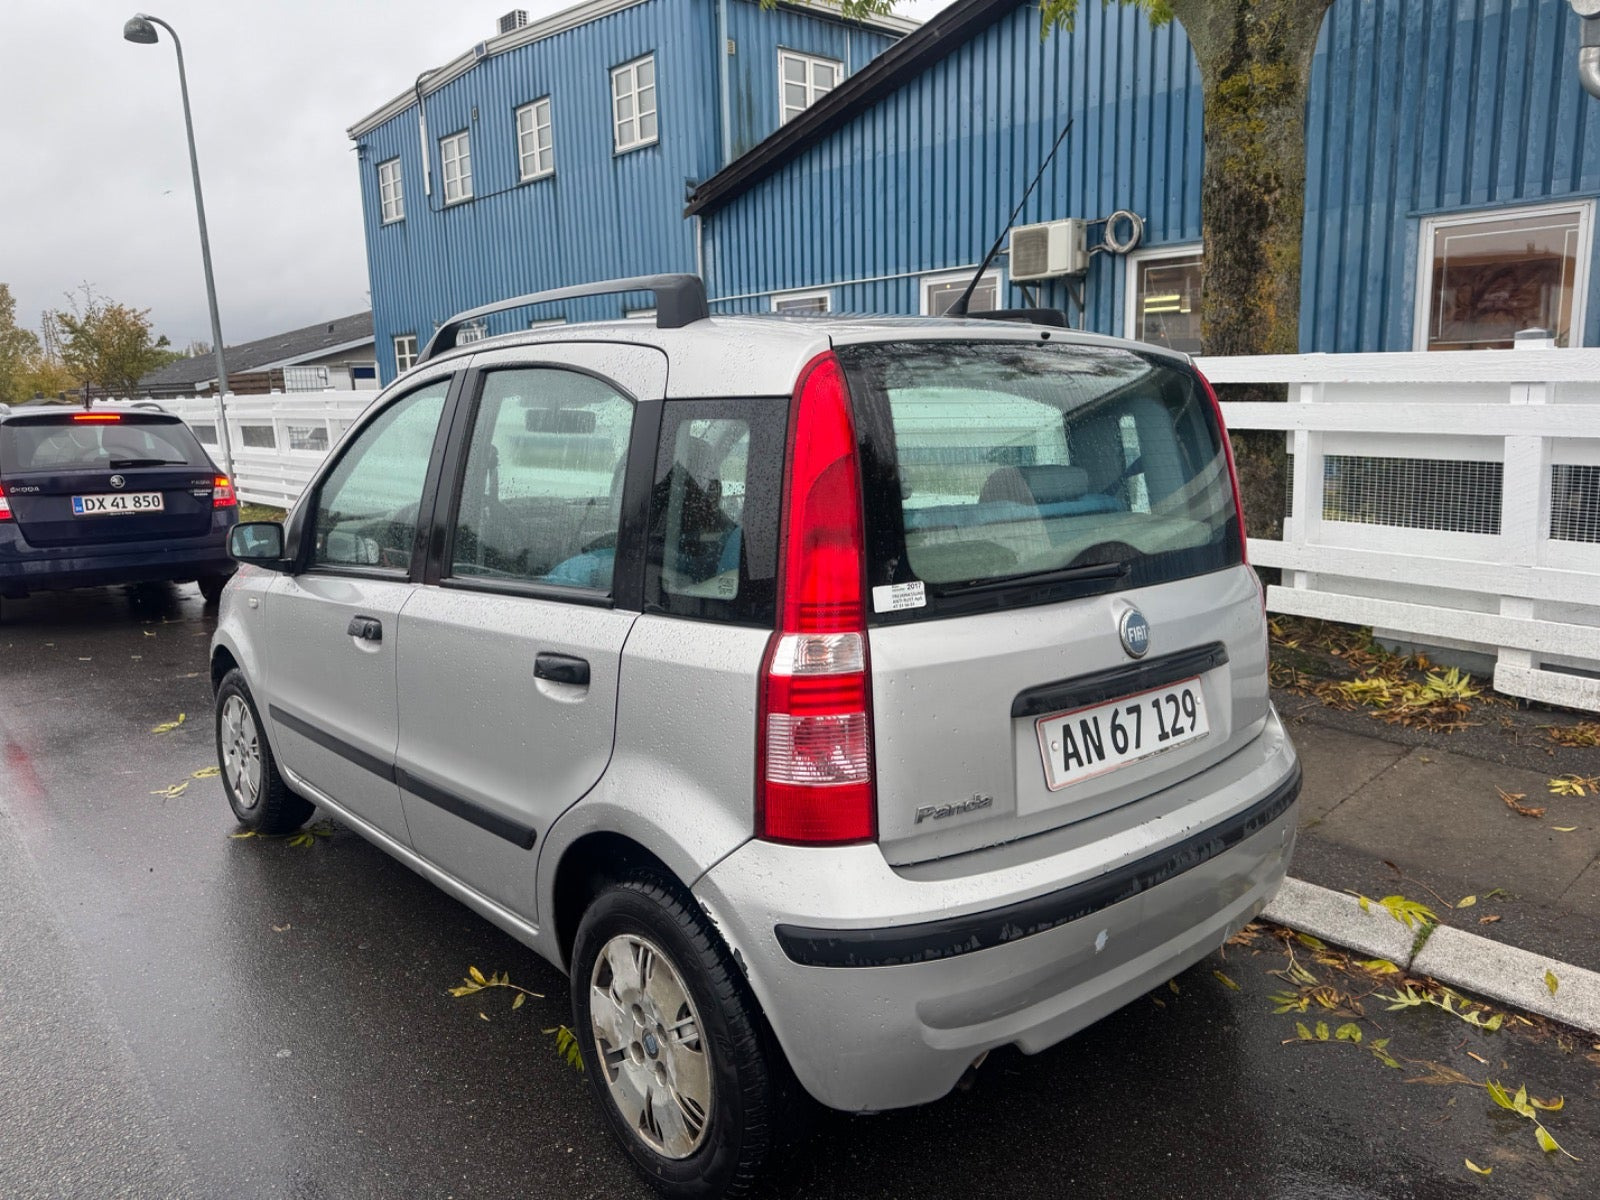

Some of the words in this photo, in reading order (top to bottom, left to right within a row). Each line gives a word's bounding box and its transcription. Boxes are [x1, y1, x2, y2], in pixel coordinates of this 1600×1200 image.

[85, 498, 107, 511] DX
[110, 496, 128, 509] 41
[133, 495, 160, 508] 850
[1127, 625, 1147, 643] FIAT
[1062, 716, 1106, 772] AN
[1111, 704, 1142, 755] 67
[1152, 688, 1197, 742] 129
[914, 793, 993, 824] Panda
